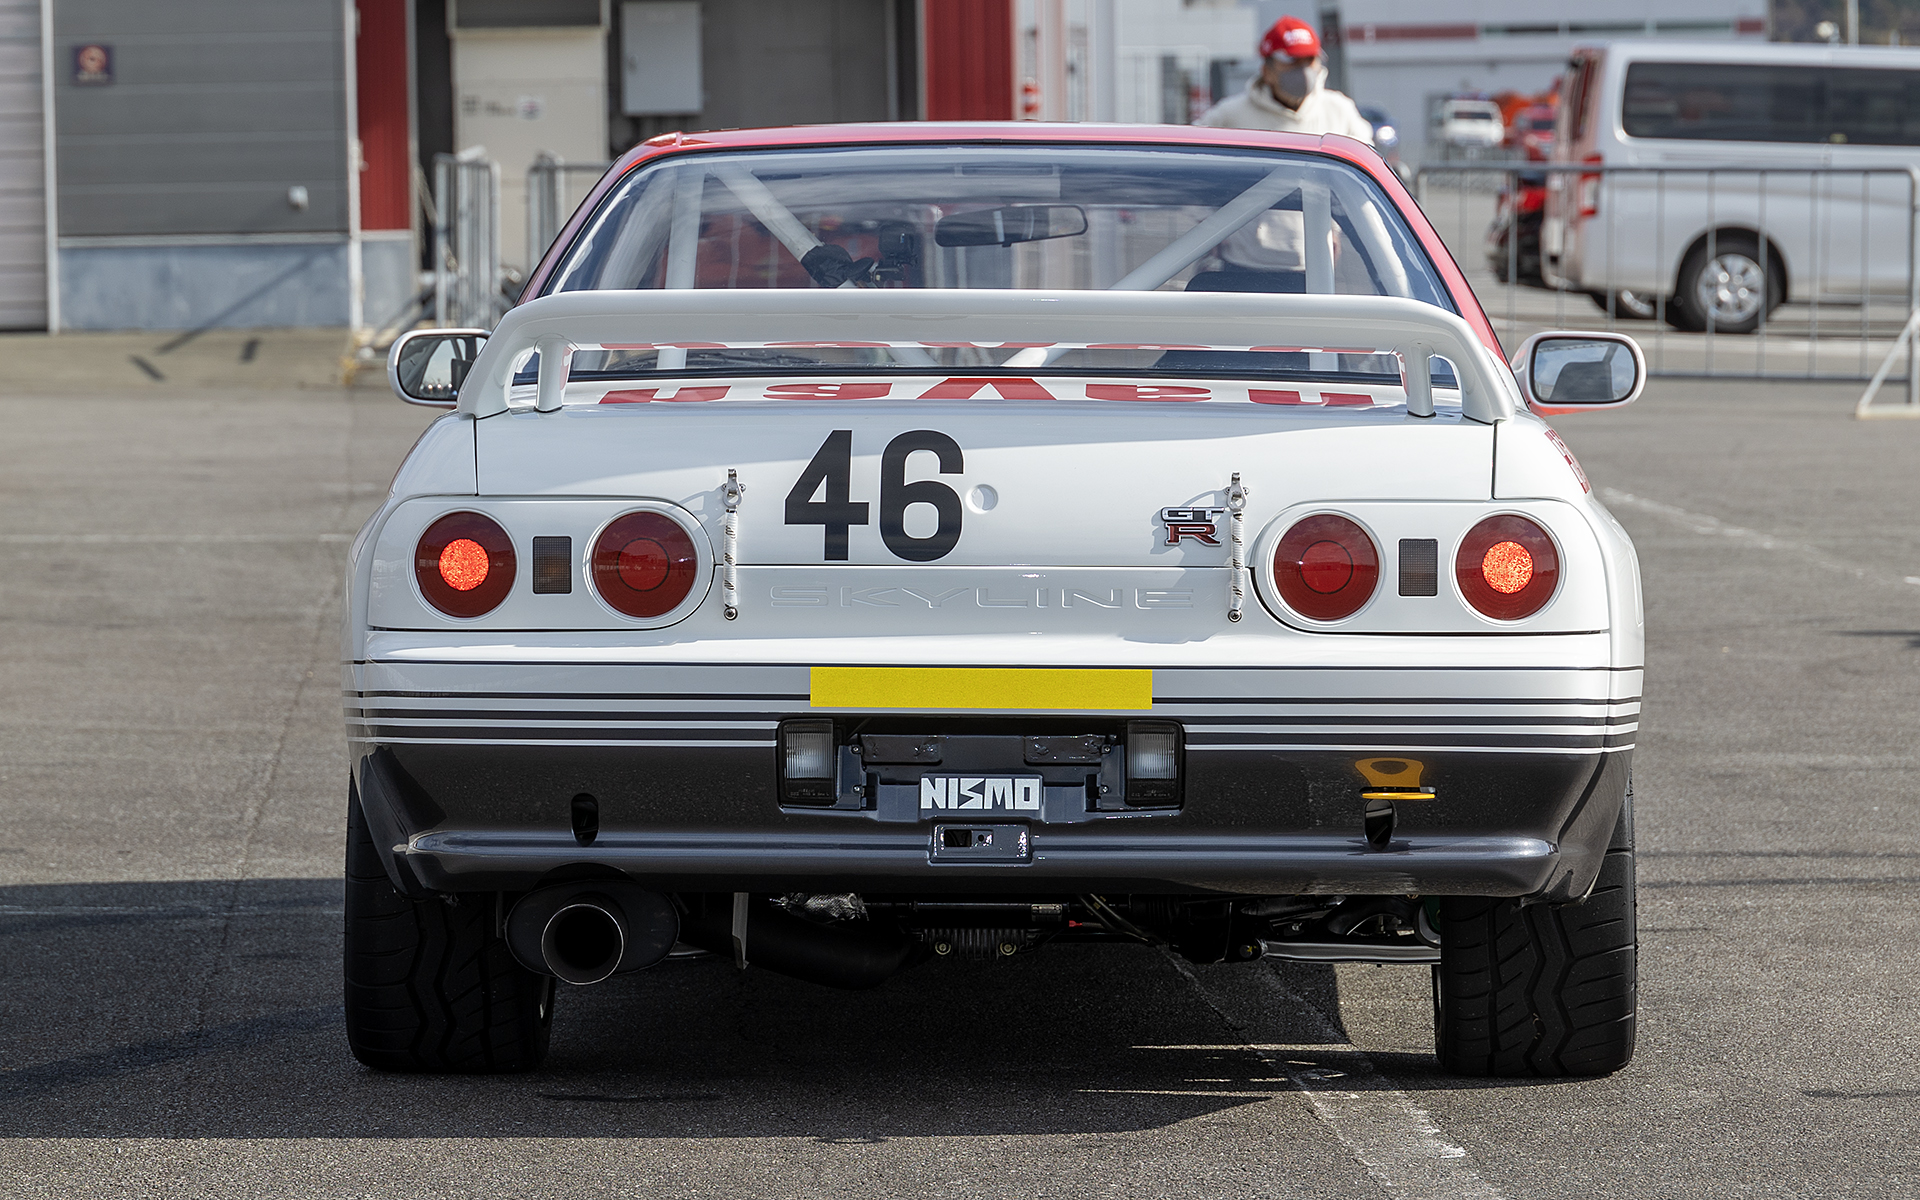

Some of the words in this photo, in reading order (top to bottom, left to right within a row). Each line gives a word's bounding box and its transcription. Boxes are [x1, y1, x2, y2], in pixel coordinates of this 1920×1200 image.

[784, 430, 964, 562] 46
[769, 585, 1195, 609] SKYLINE
[920, 777, 1040, 810] NISMO
